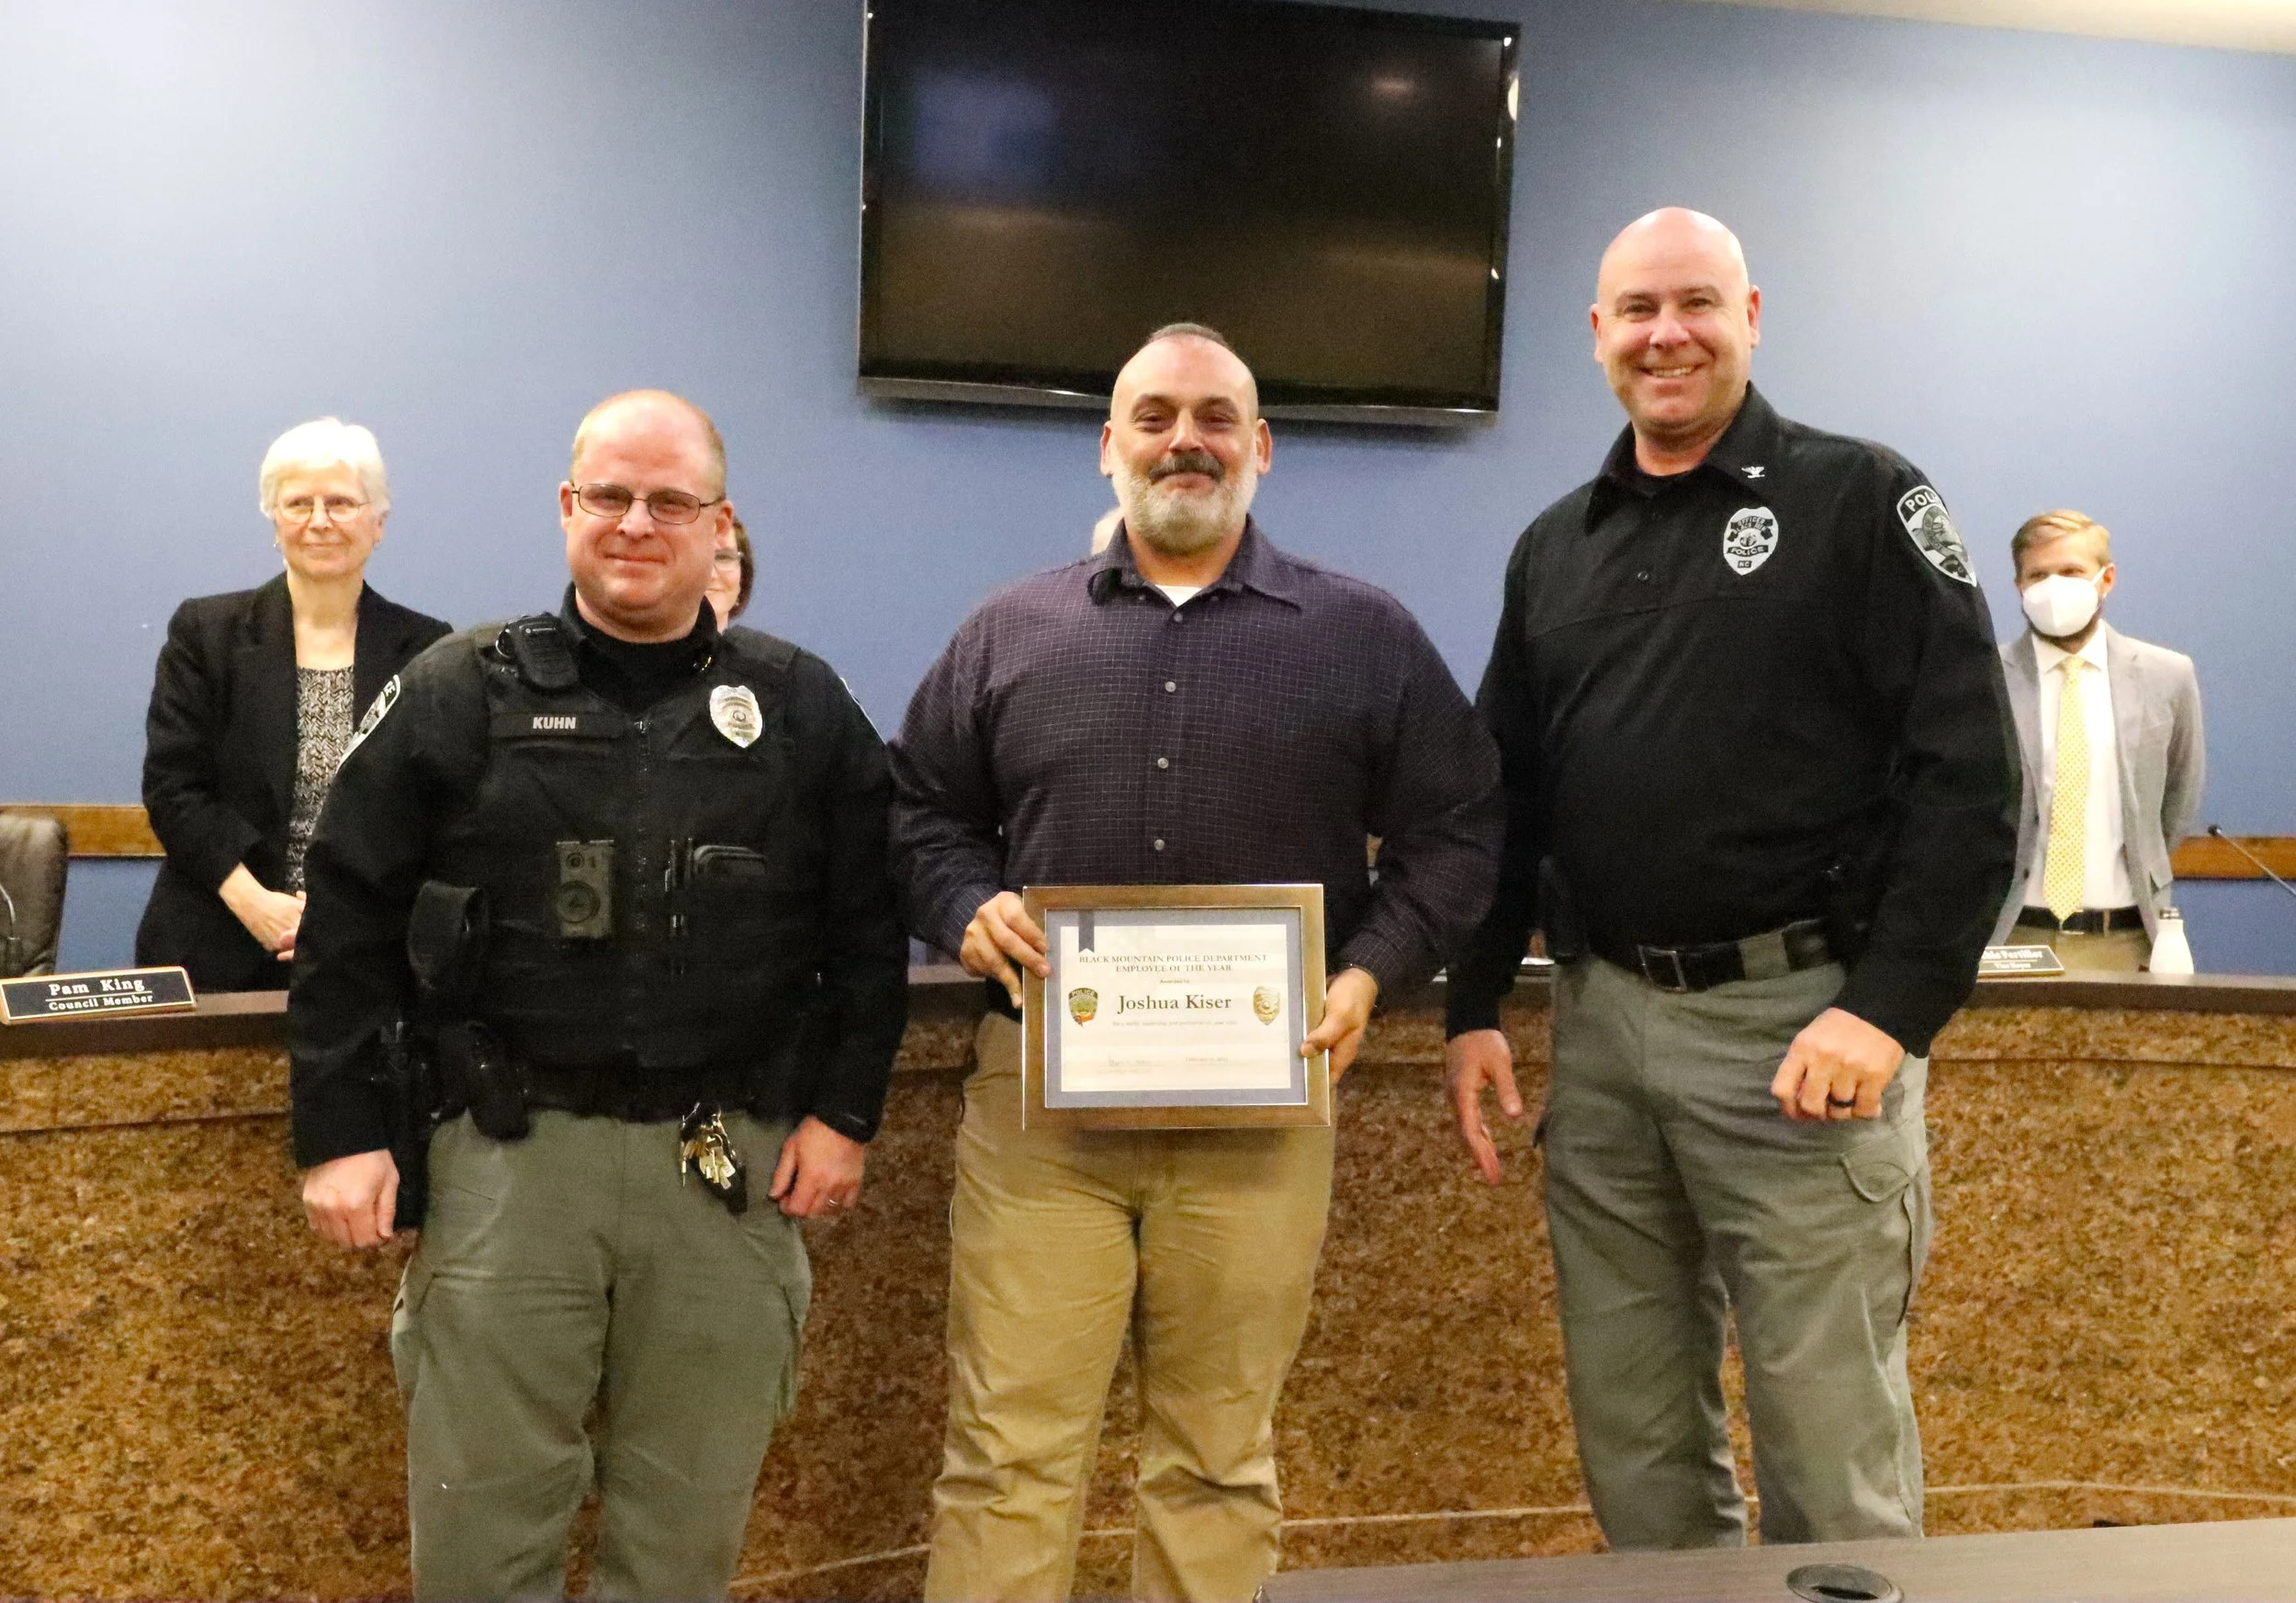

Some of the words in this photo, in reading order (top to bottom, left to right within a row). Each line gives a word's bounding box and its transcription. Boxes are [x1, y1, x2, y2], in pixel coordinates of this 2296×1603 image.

[1731, 546, 1764, 556] POLICE
[533, 717, 577, 729] KUHN
[1079, 955, 1109, 964] BLACK
[1166, 954, 1199, 963] POLICE
[49, 983, 89, 996] Pam
[100, 978, 145, 992] King
[49, 997, 98, 1010] Council
[104, 994, 153, 1006] Member
[1117, 995, 1178, 1014] Joshua
[1186, 994, 1232, 1010] Kiser
